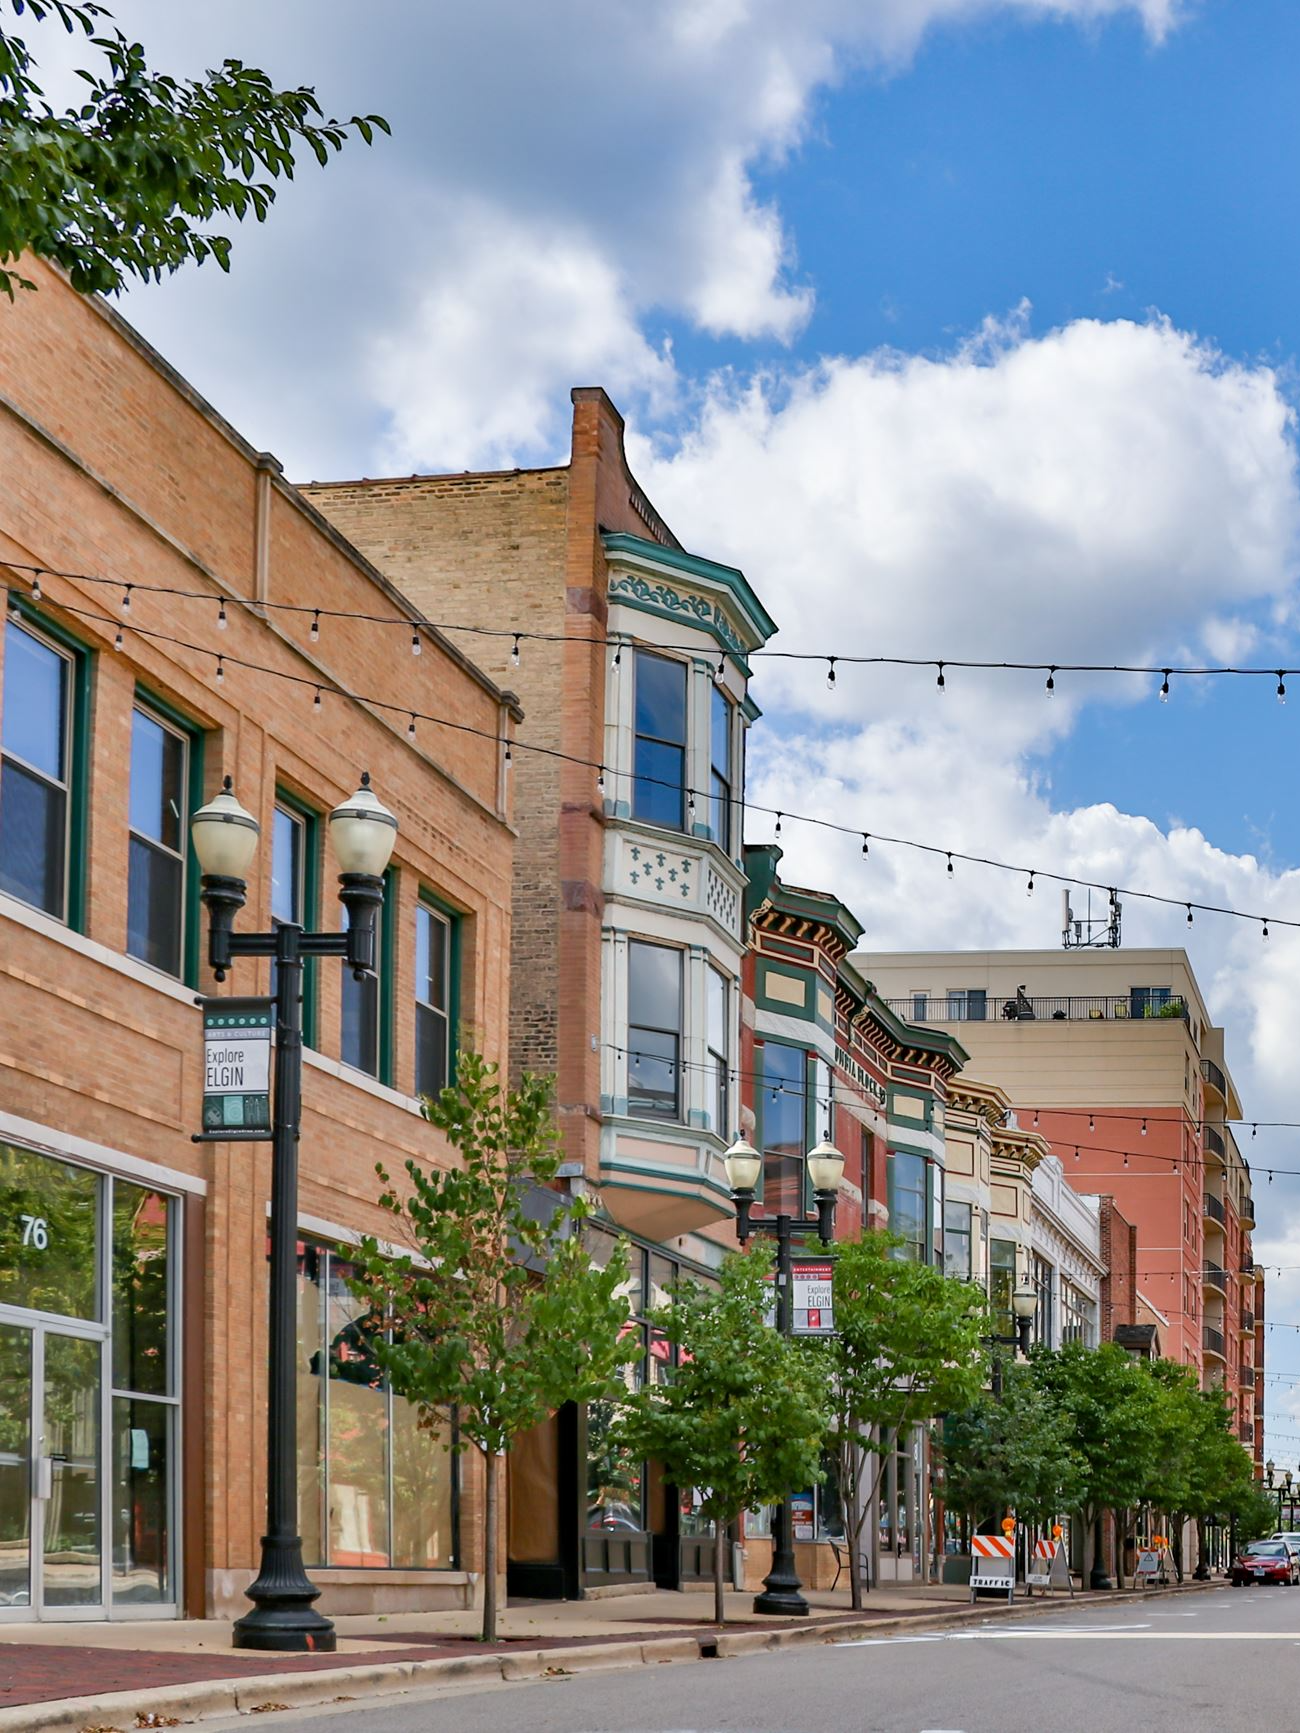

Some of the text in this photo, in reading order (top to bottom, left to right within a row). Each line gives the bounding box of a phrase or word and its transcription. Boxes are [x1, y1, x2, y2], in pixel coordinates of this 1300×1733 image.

[207, 1048, 244, 1065] Explore
[207, 1067, 244, 1087] ELGIN
[20, 1214, 48, 1250] 76
[808, 1285, 830, 1295] Explore
[808, 1296, 830, 1307] ELGIN
[973, 1578, 1011, 1587] TRAFFIC
